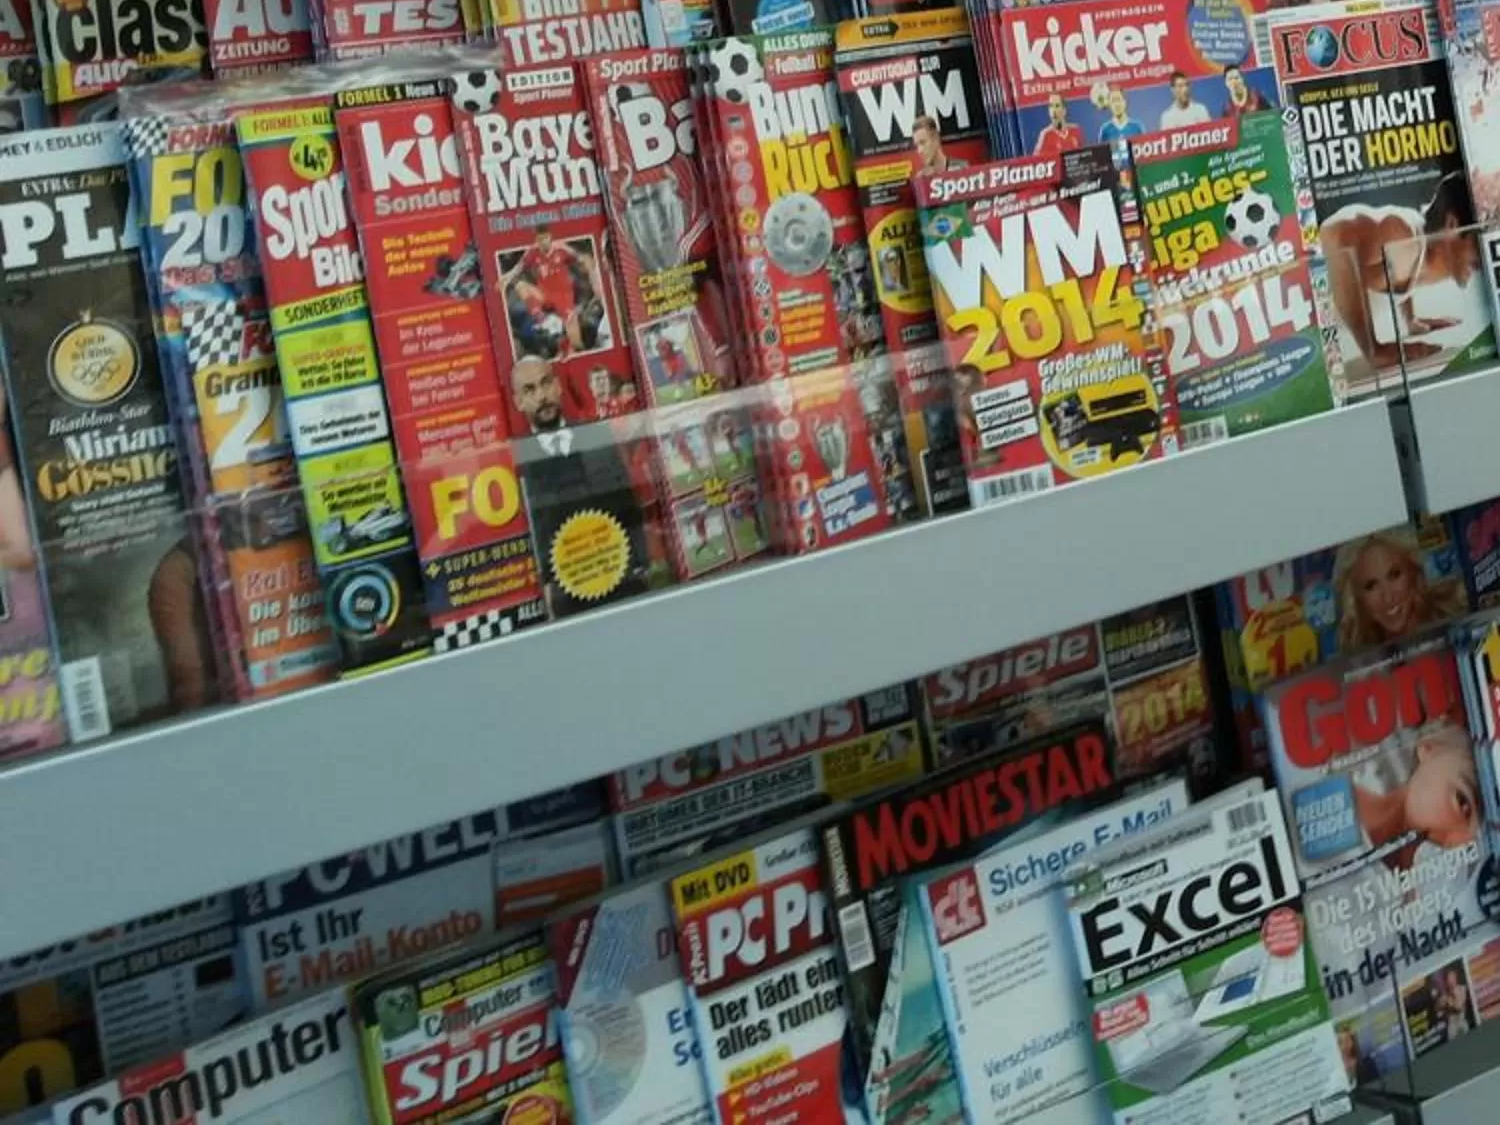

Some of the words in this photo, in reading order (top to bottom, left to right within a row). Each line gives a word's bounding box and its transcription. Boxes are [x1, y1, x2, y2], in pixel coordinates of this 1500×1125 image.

[216, 39, 291, 60] ZEITUNG
[504, 10, 645, 66] TESTJAHR
[1012, 13, 1170, 81] kicker
[1279, 17, 1424, 74] FOCUS
[509, 69, 572, 88] EDITION
[601, 57, 648, 80] Sport
[1022, 82, 1053, 95] Extra
[337, 88, 390, 107] FORMEL
[856, 70, 970, 143] WM
[1302, 106, 1348, 142] DIE
[1351, 86, 1438, 132] MACHT
[1170, 123, 1230, 154] Planer
[1308, 135, 1364, 179] DER
[1366, 119, 1457, 169] HORMO
[930, 174, 985, 200] Sport
[989, 157, 1057, 187] Planer
[1153, 180, 1180, 197] und
[926, 189, 1128, 312] WM
[946, 263, 1145, 373] 2014
[1162, 277, 1313, 375] 2014
[855, 729, 1115, 886] MOVIESTAR
[680, 886, 711, 905] Mit
[714, 862, 751, 891] DVD
[988, 838, 1088, 896] Sichere
[1080, 835, 1287, 970] Excel
[1309, 893, 1350, 929] Die
[1355, 883, 1381, 913] 15
[257, 926, 302, 962] Ist
[315, 906, 365, 944] Ihr
[264, 907, 484, 1000] E-Mail-Konto
[706, 894, 766, 979] PC
[1322, 968, 1350, 1000] in
[1358, 947, 1397, 988] der
[1400, 909, 1468, 970] Nacht
[1340, 924, 1377, 955] des
[708, 999, 751, 1031] Der
[755, 974, 799, 1008] lädt
[68, 1006, 348, 1125] Computer
[715, 1023, 773, 1061] alles
[990, 1074, 1014, 1102] für
[1016, 1062, 1046, 1089] alle
